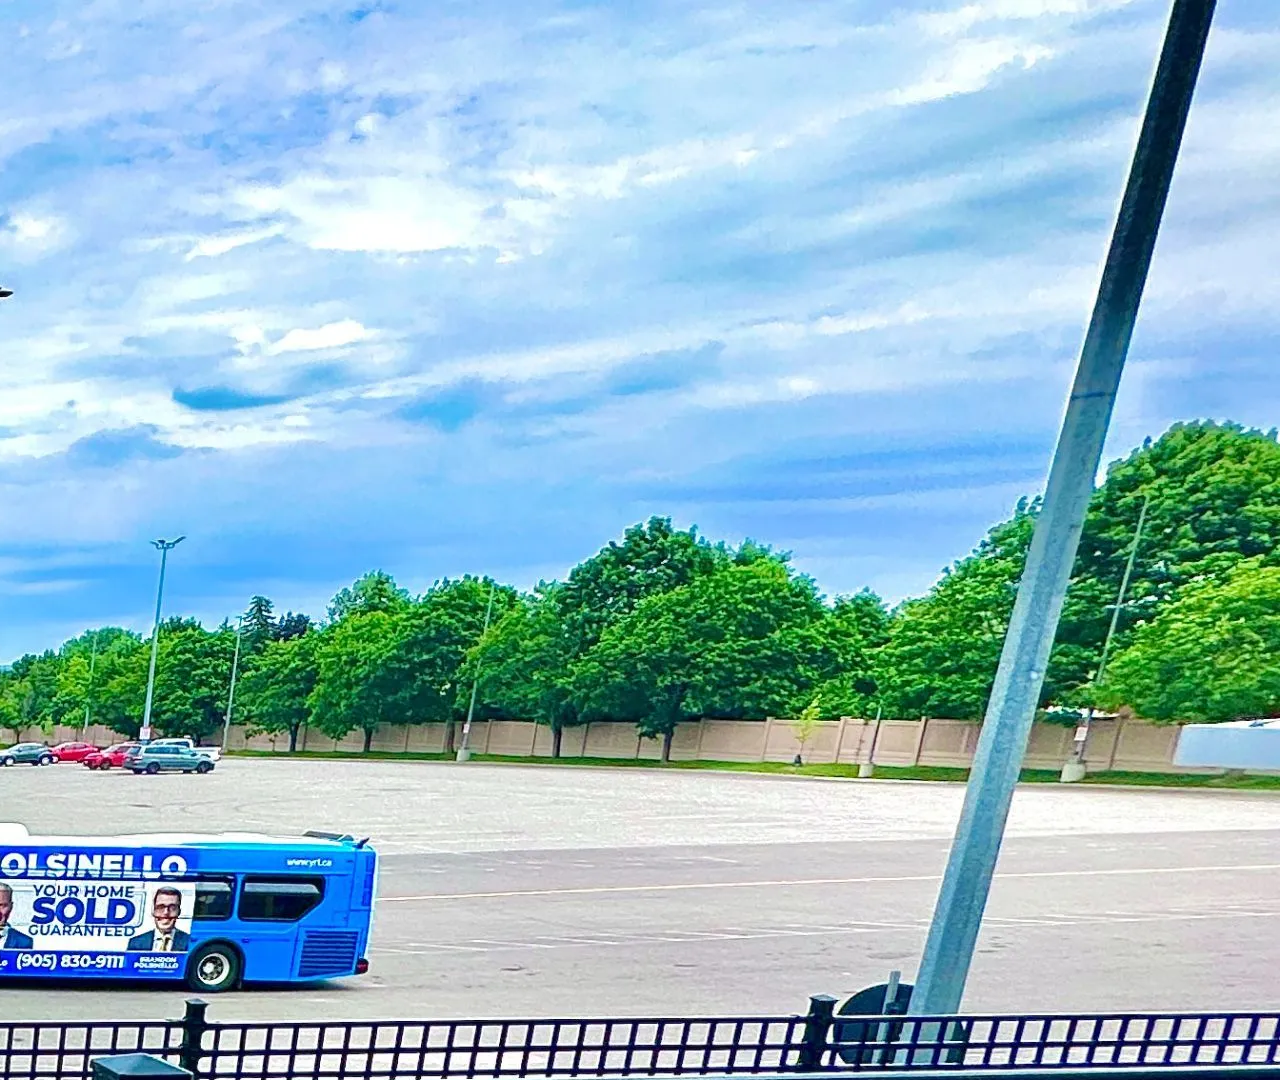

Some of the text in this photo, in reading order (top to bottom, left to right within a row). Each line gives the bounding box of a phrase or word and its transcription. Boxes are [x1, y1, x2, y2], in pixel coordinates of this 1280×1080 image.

[287, 858, 332, 868] www.yrt.ca
[33, 885, 135, 898] YOUR HOME
[31, 897, 136, 925] SOLD
[28, 924, 136, 937] GUARANTEED
[16, 953, 125, 970] (905) 830-9111
